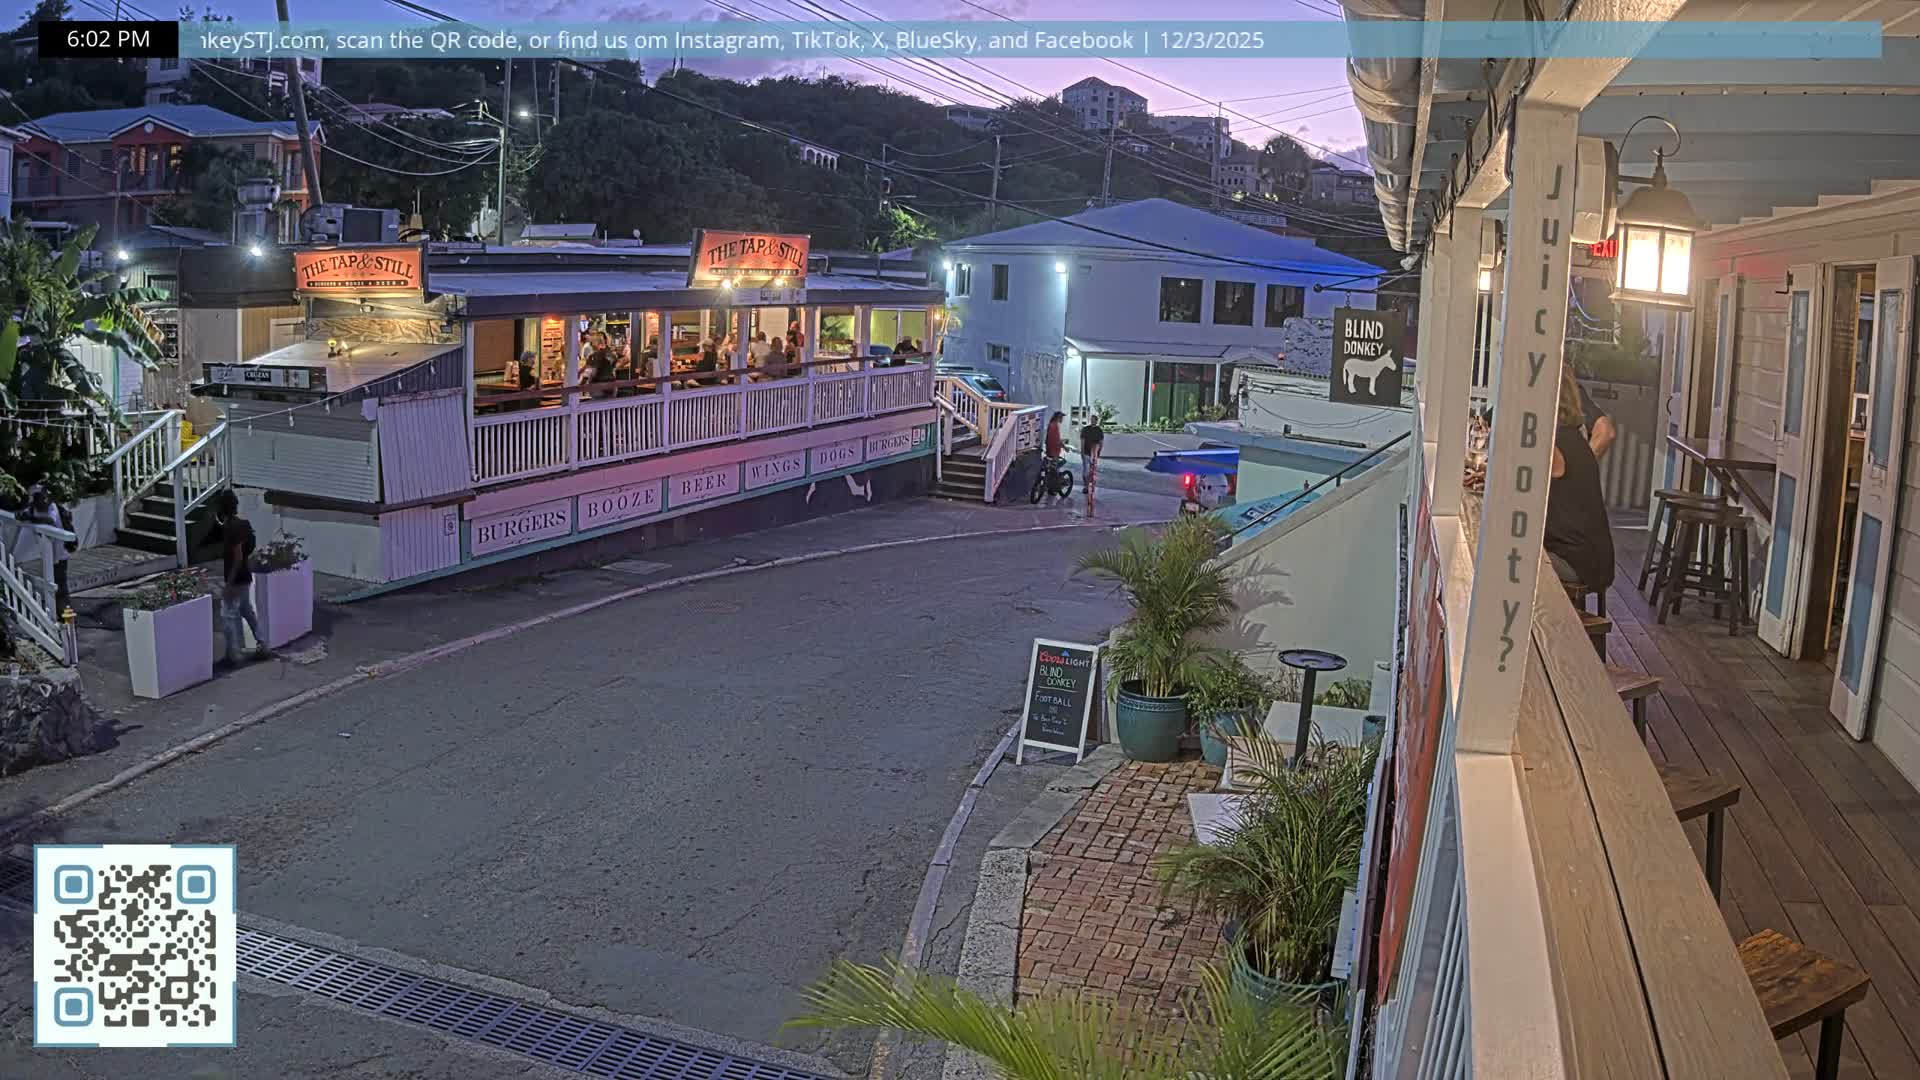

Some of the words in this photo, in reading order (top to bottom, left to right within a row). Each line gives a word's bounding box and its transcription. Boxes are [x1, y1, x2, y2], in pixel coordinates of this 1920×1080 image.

[708, 242, 737, 265] THE
[739, 238, 766, 255] TAP
[778, 242, 803, 268] STILL
[301, 259, 329, 280] THE
[329, 255, 358, 270] TAP
[374, 256, 414, 279] STILL
[1527, 164, 1563, 388] Juicy
[1344, 318, 1384, 340] BLIND
[1343, 340, 1384, 356] DONKEY
[869, 433, 910, 453] BURGERS
[751, 457, 801, 480] WINGS
[819, 447, 855, 466] DOGS
[682, 472, 727, 497] BEER
[587, 488, 655, 519] BOOZE
[477, 510, 567, 546] BURGERS
[1498, 411, 1538, 673] Booty?
[1039, 665, 1064, 679] BLIND
[1065, 658, 1090, 668] LIGHT
